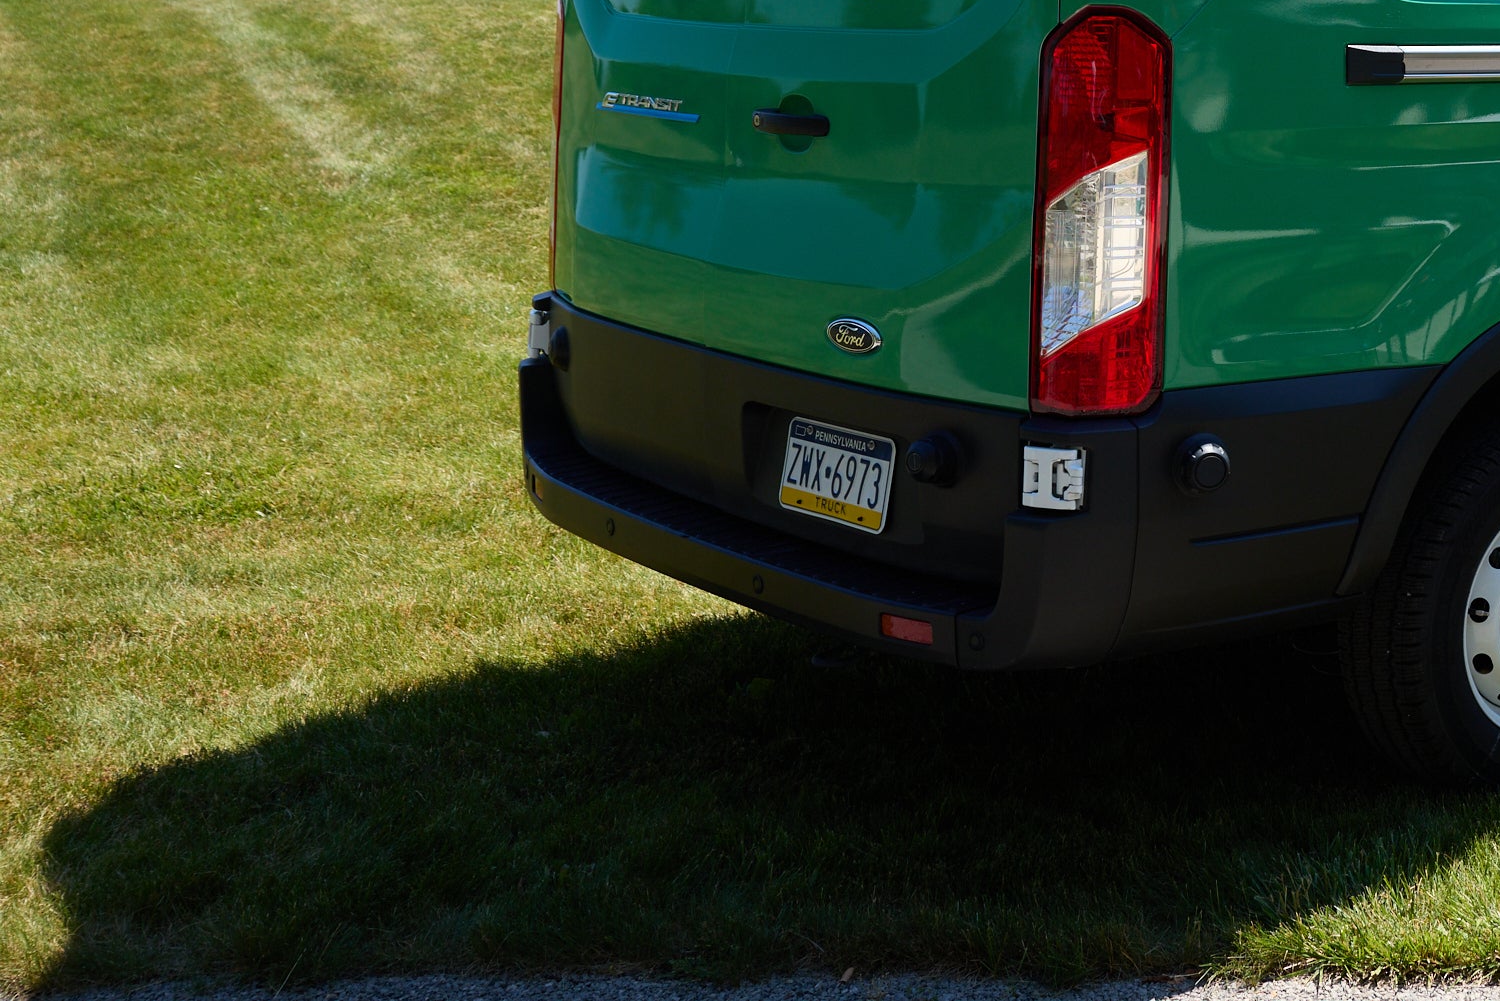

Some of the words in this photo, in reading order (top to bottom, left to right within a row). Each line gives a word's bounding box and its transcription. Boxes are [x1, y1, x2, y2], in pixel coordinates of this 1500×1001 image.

[835, 324, 866, 347] Ford
[815, 430, 867, 452] PENNSYLVANIA
[815, 496, 846, 515] TRUCK
